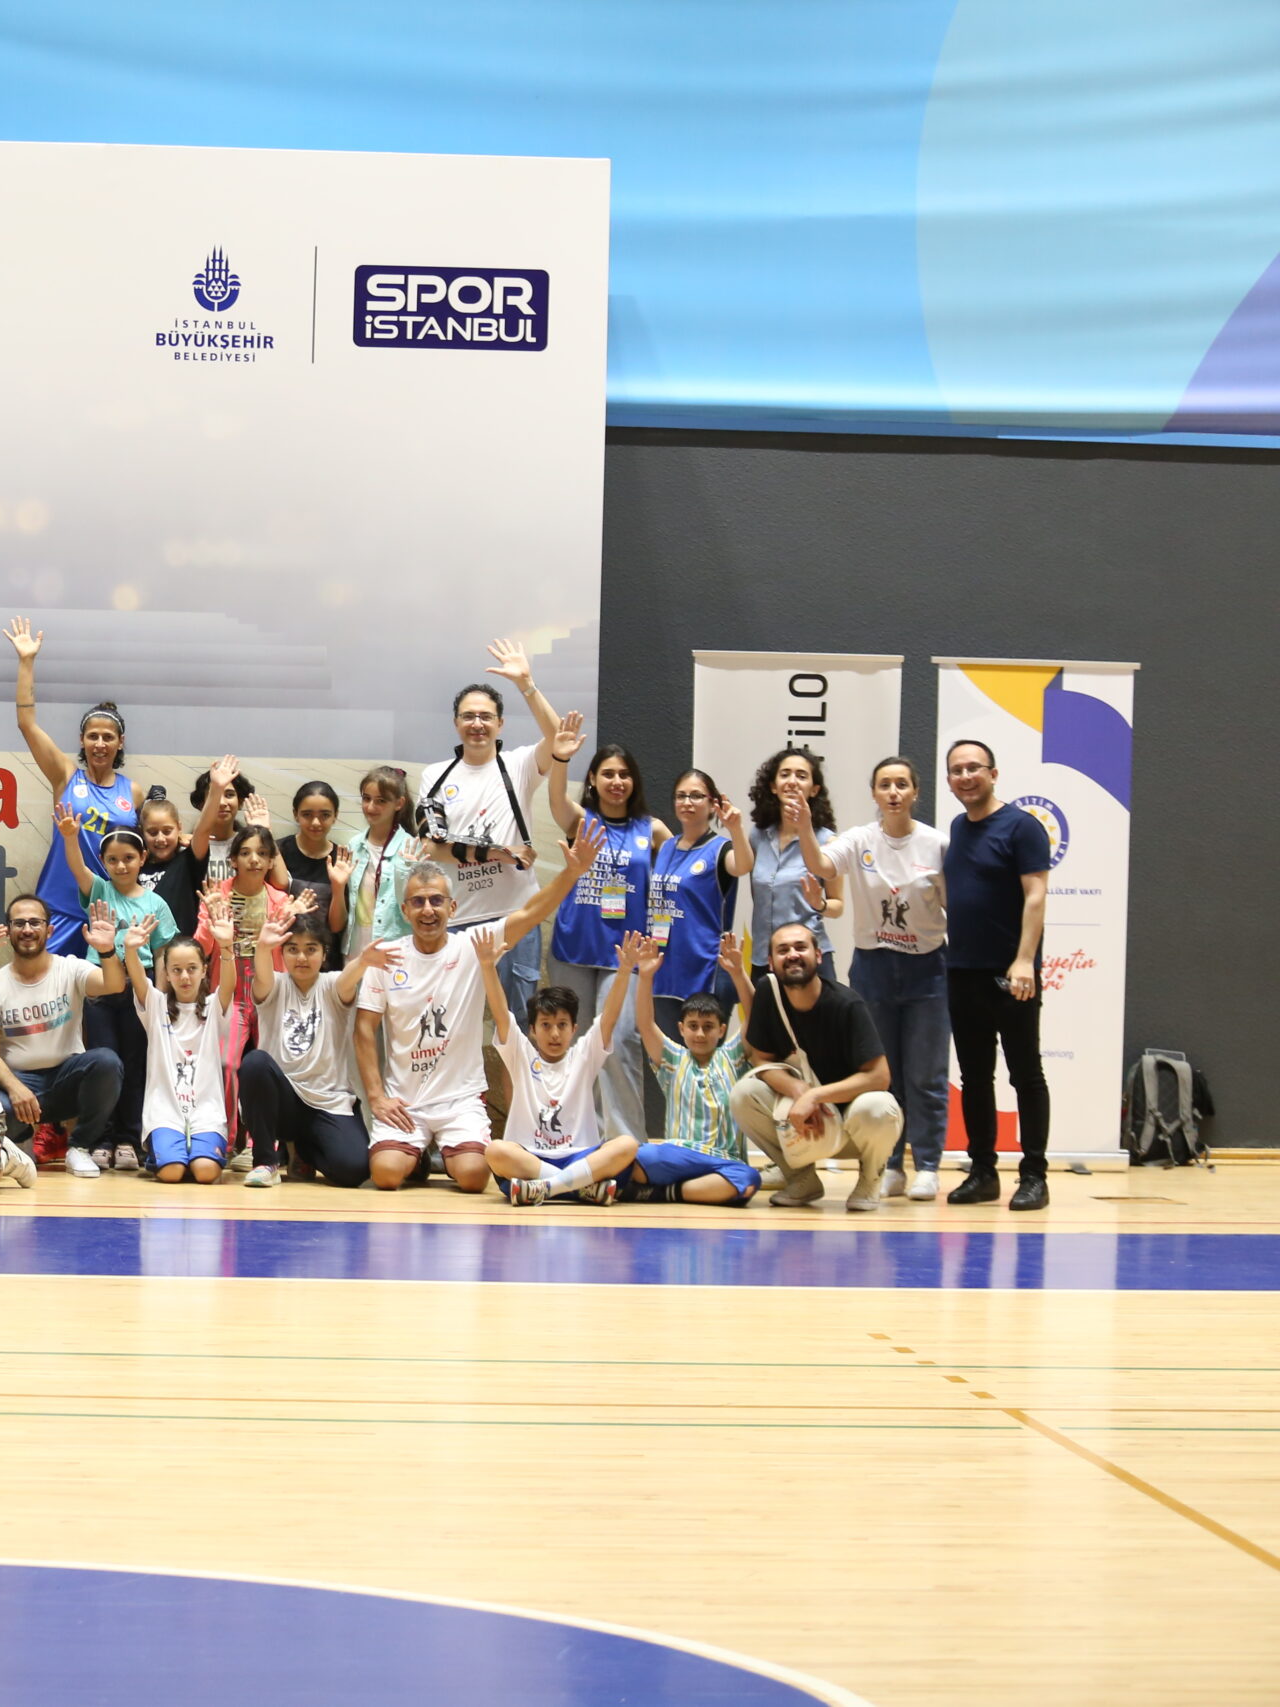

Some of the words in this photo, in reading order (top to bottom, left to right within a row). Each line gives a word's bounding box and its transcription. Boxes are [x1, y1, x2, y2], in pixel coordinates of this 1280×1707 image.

[366, 273, 537, 315] SPOR
[175, 318, 256, 330] İSTANBUL
[156, 330, 274, 349] BÜYÜKŞEHİR
[174, 352, 256, 362] BELEDİYESİ
[82, 806, 109, 835] 21
[458, 863, 504, 881] basket
[467, 878, 494, 892] 2023
[22, 993, 70, 1021] COOPER
